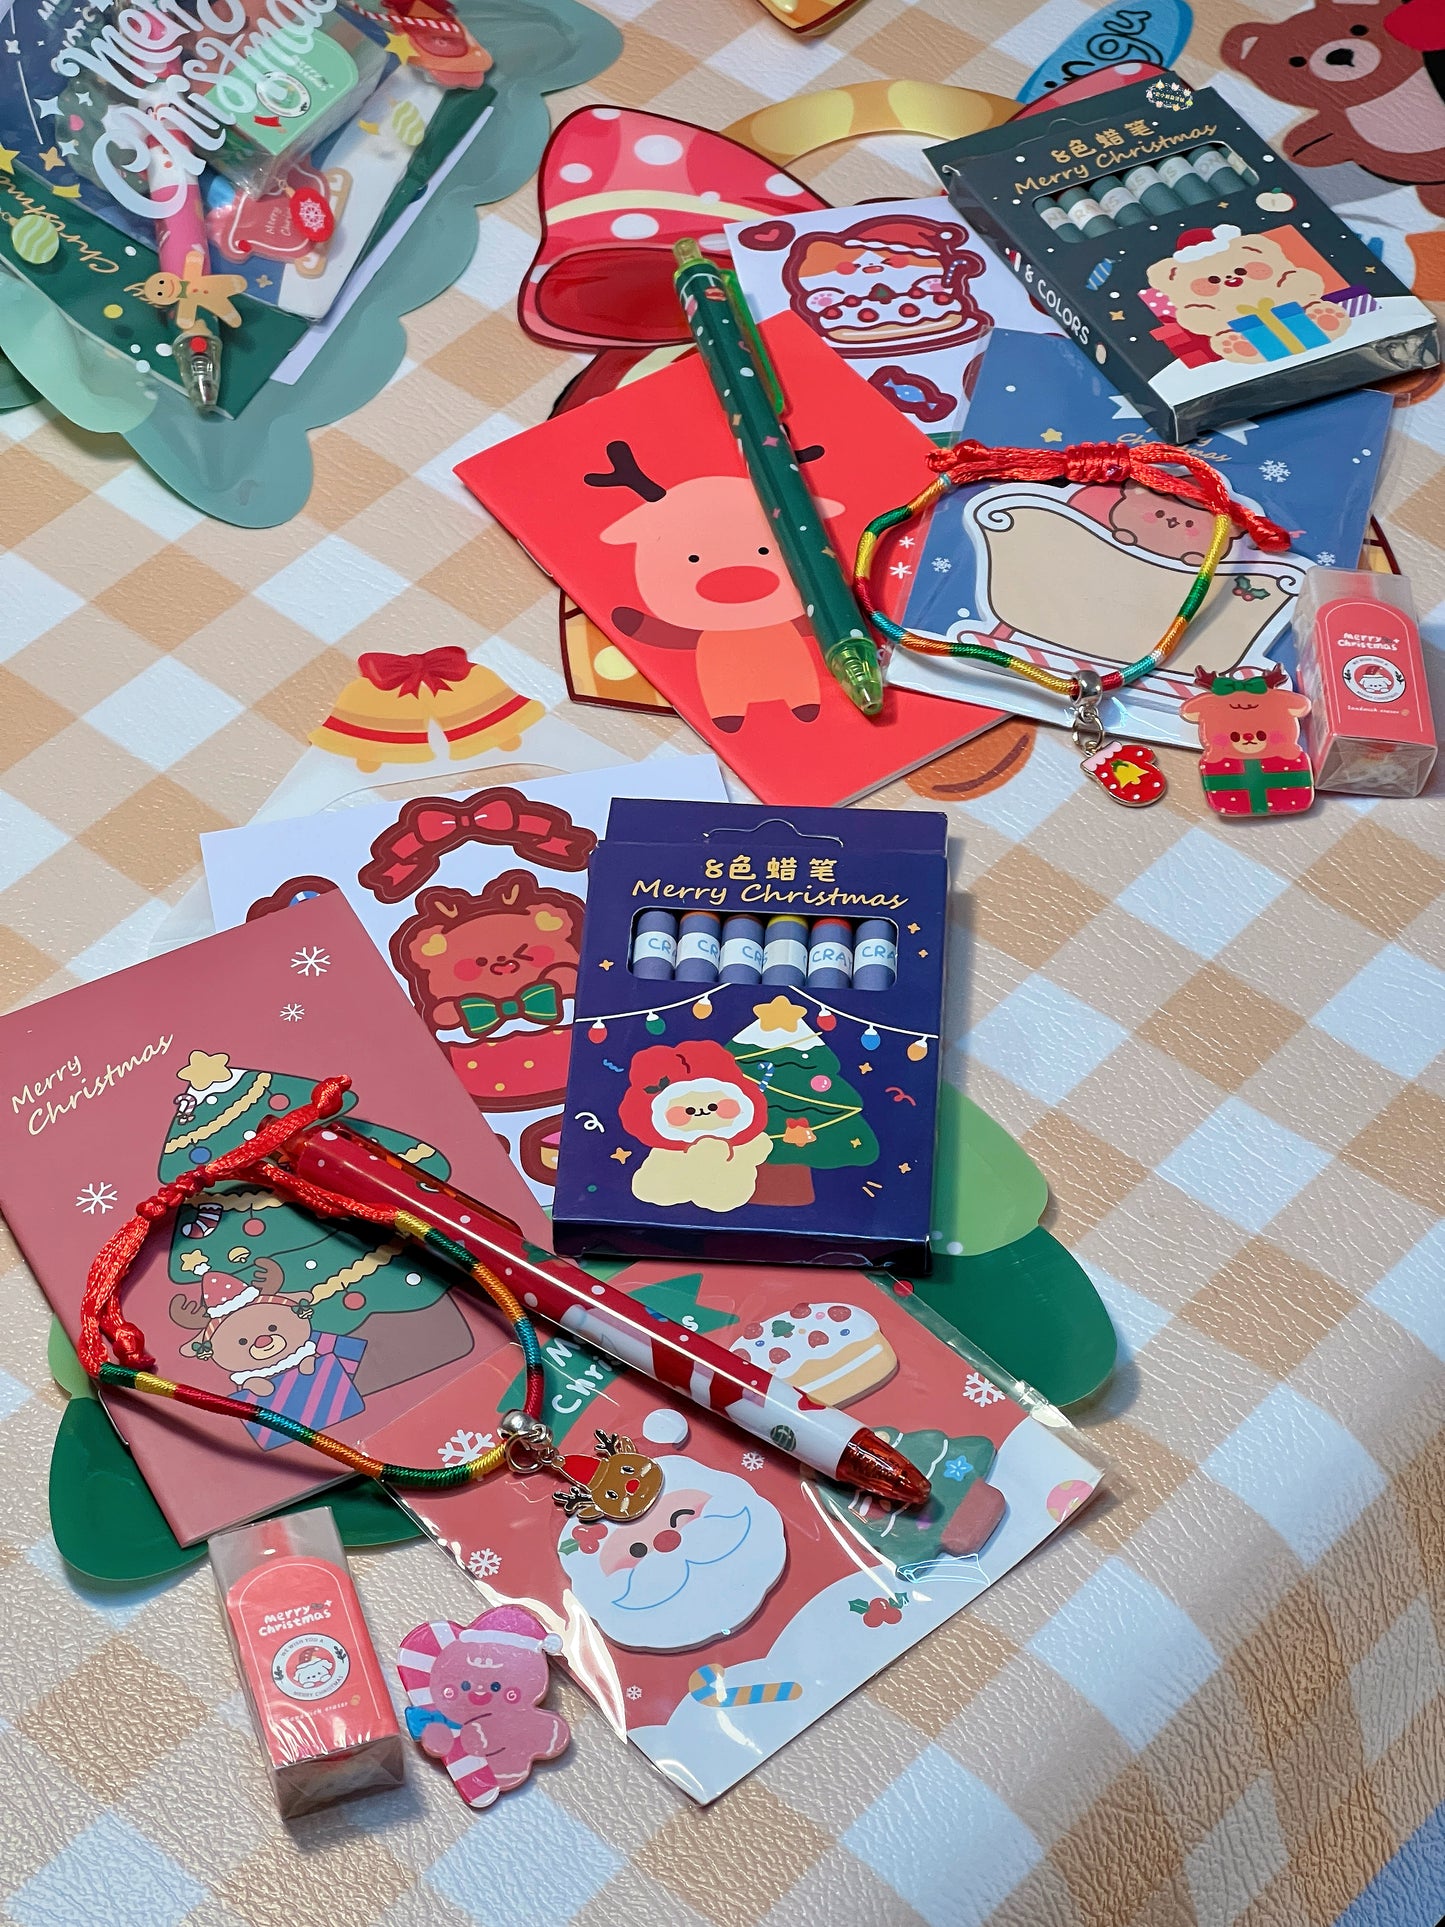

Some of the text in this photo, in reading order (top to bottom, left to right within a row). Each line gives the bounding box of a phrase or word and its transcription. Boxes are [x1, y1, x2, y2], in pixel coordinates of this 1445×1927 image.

[1013, 124, 1218, 195] Merry Christmas
[1038, 279, 1090, 345] COLORS
[1337, 639, 1398, 651] Christmas
[631, 878, 909, 910] Merry Christmas
[12, 1055, 82, 1114] Merry
[28, 1034, 174, 1136] Christmas
[258, 1609, 332, 1636] Christmas
